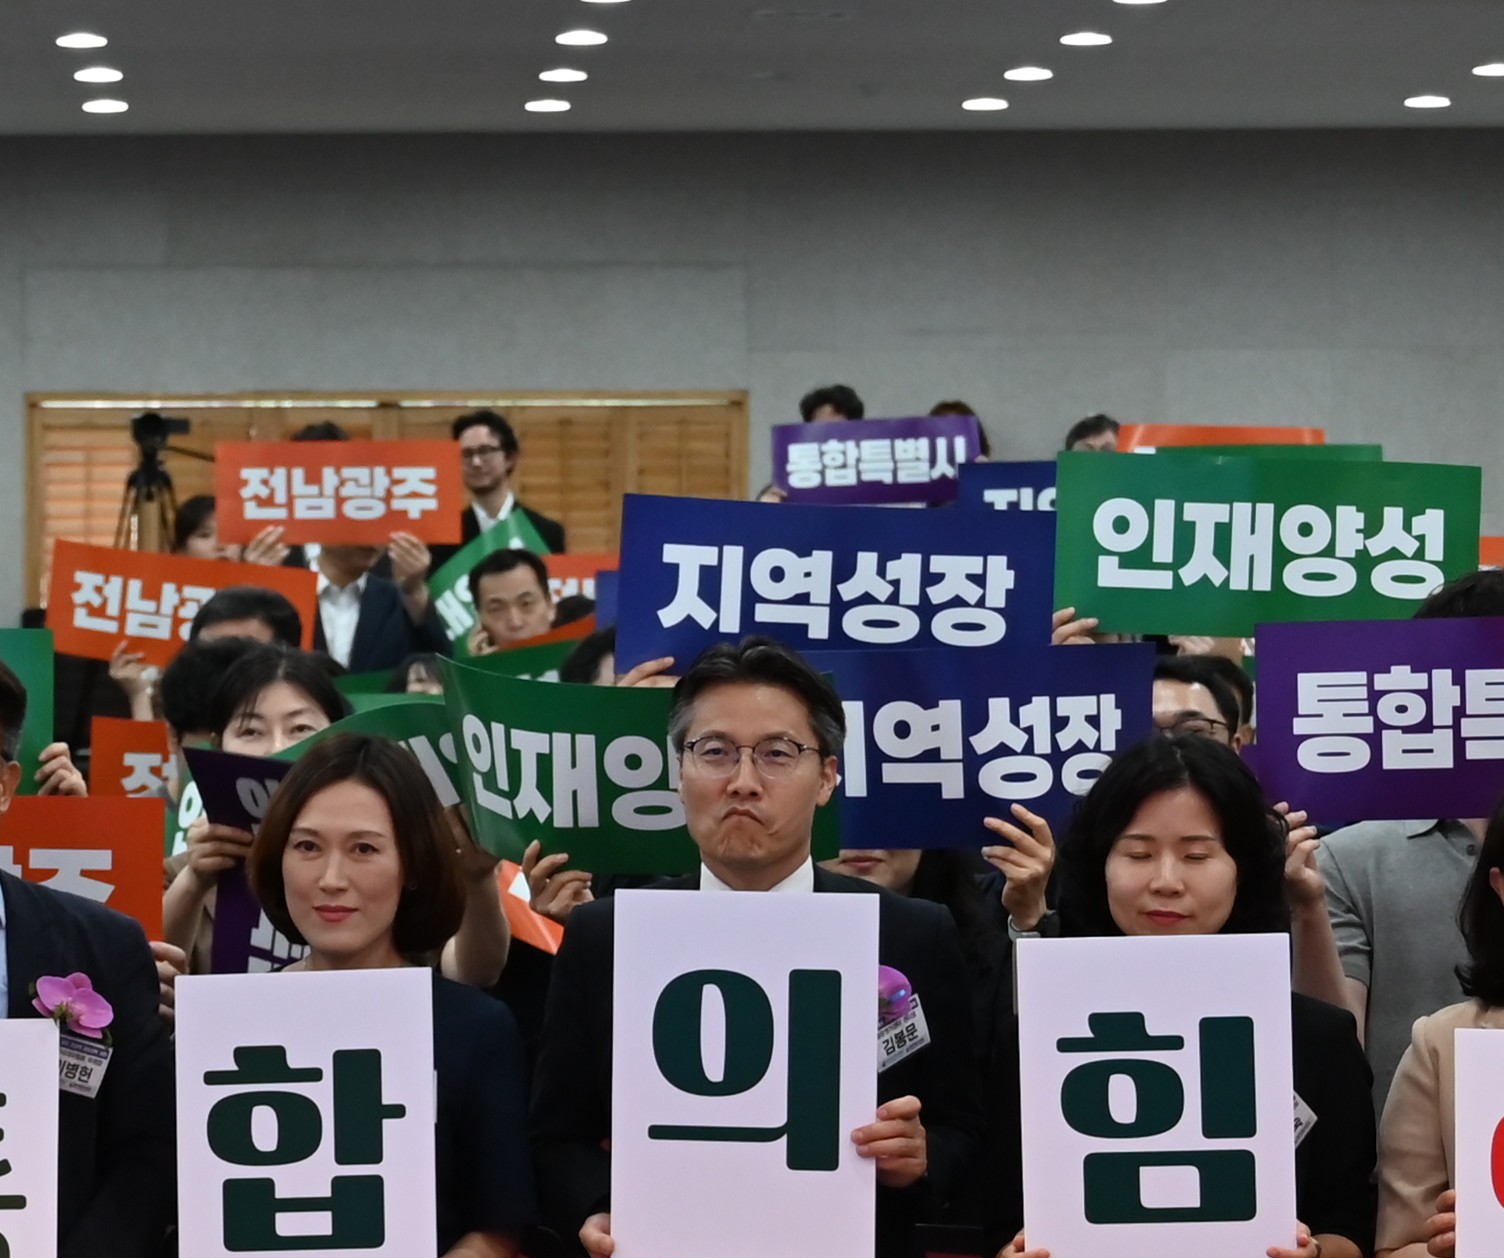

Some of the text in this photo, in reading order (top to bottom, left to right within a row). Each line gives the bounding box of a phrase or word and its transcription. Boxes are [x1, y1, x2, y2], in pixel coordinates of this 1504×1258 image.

[239, 466, 438, 522] 전남광주
[786, 435, 966, 488] 통합특별시
[658, 542, 1015, 647] 지역성장
[1093, 497, 1445, 599] 인재양성
[71, 570, 215, 641] 전남
[462, 714, 686, 831] 인재양
[646, 967, 843, 1172] 의
[1055, 1010, 1258, 1225] 힘
[203, 1044, 407, 1253] 합
